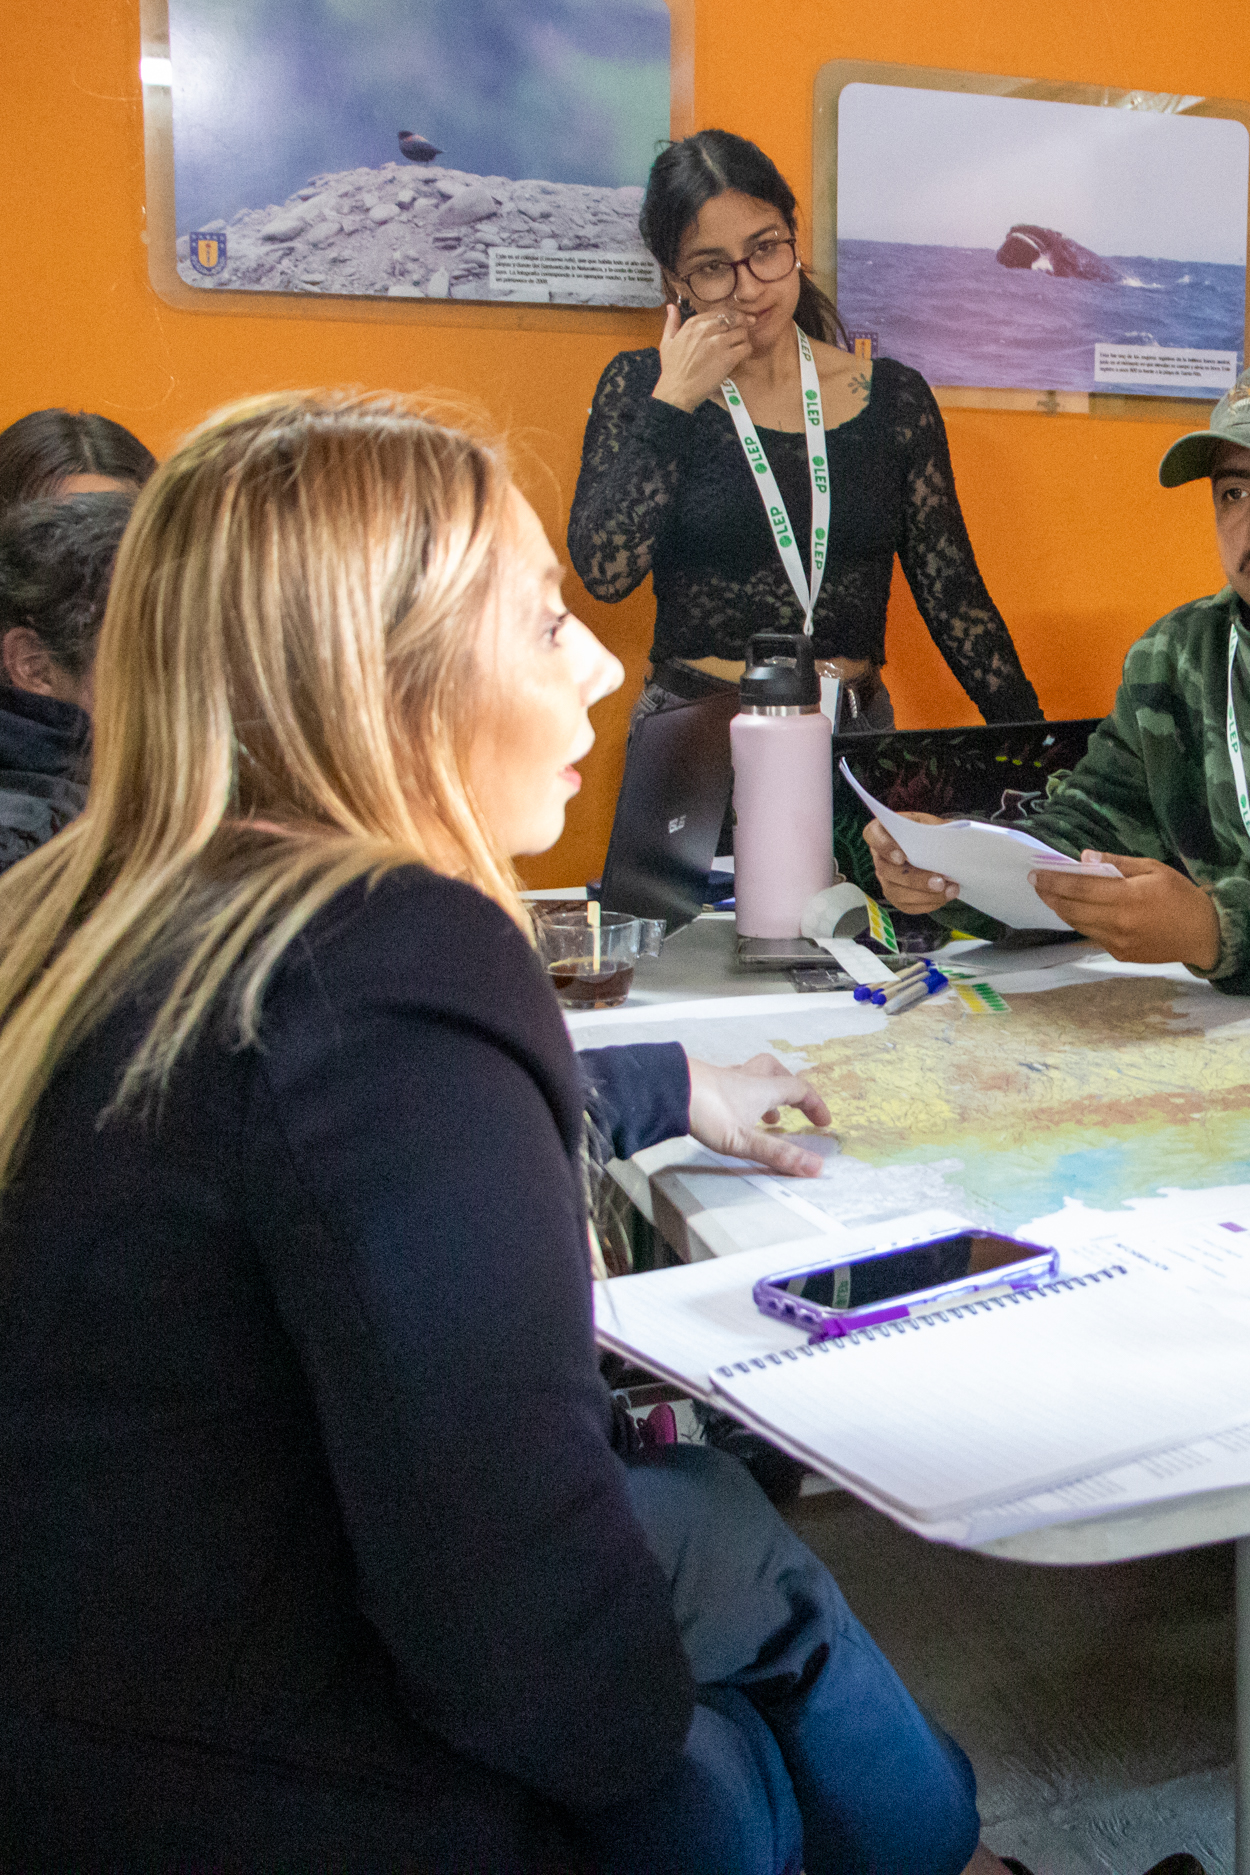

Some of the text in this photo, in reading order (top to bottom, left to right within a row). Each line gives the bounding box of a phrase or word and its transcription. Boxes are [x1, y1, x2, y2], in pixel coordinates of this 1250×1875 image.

[801, 339, 812, 362] LEP
[806, 402, 820, 426] LEP
[744, 436, 763, 465] LEP
[813, 467, 827, 494] LEP
[770, 505, 788, 538] LEP
[814, 543, 826, 570] LEP
[1228, 721, 1239, 753] LEP
